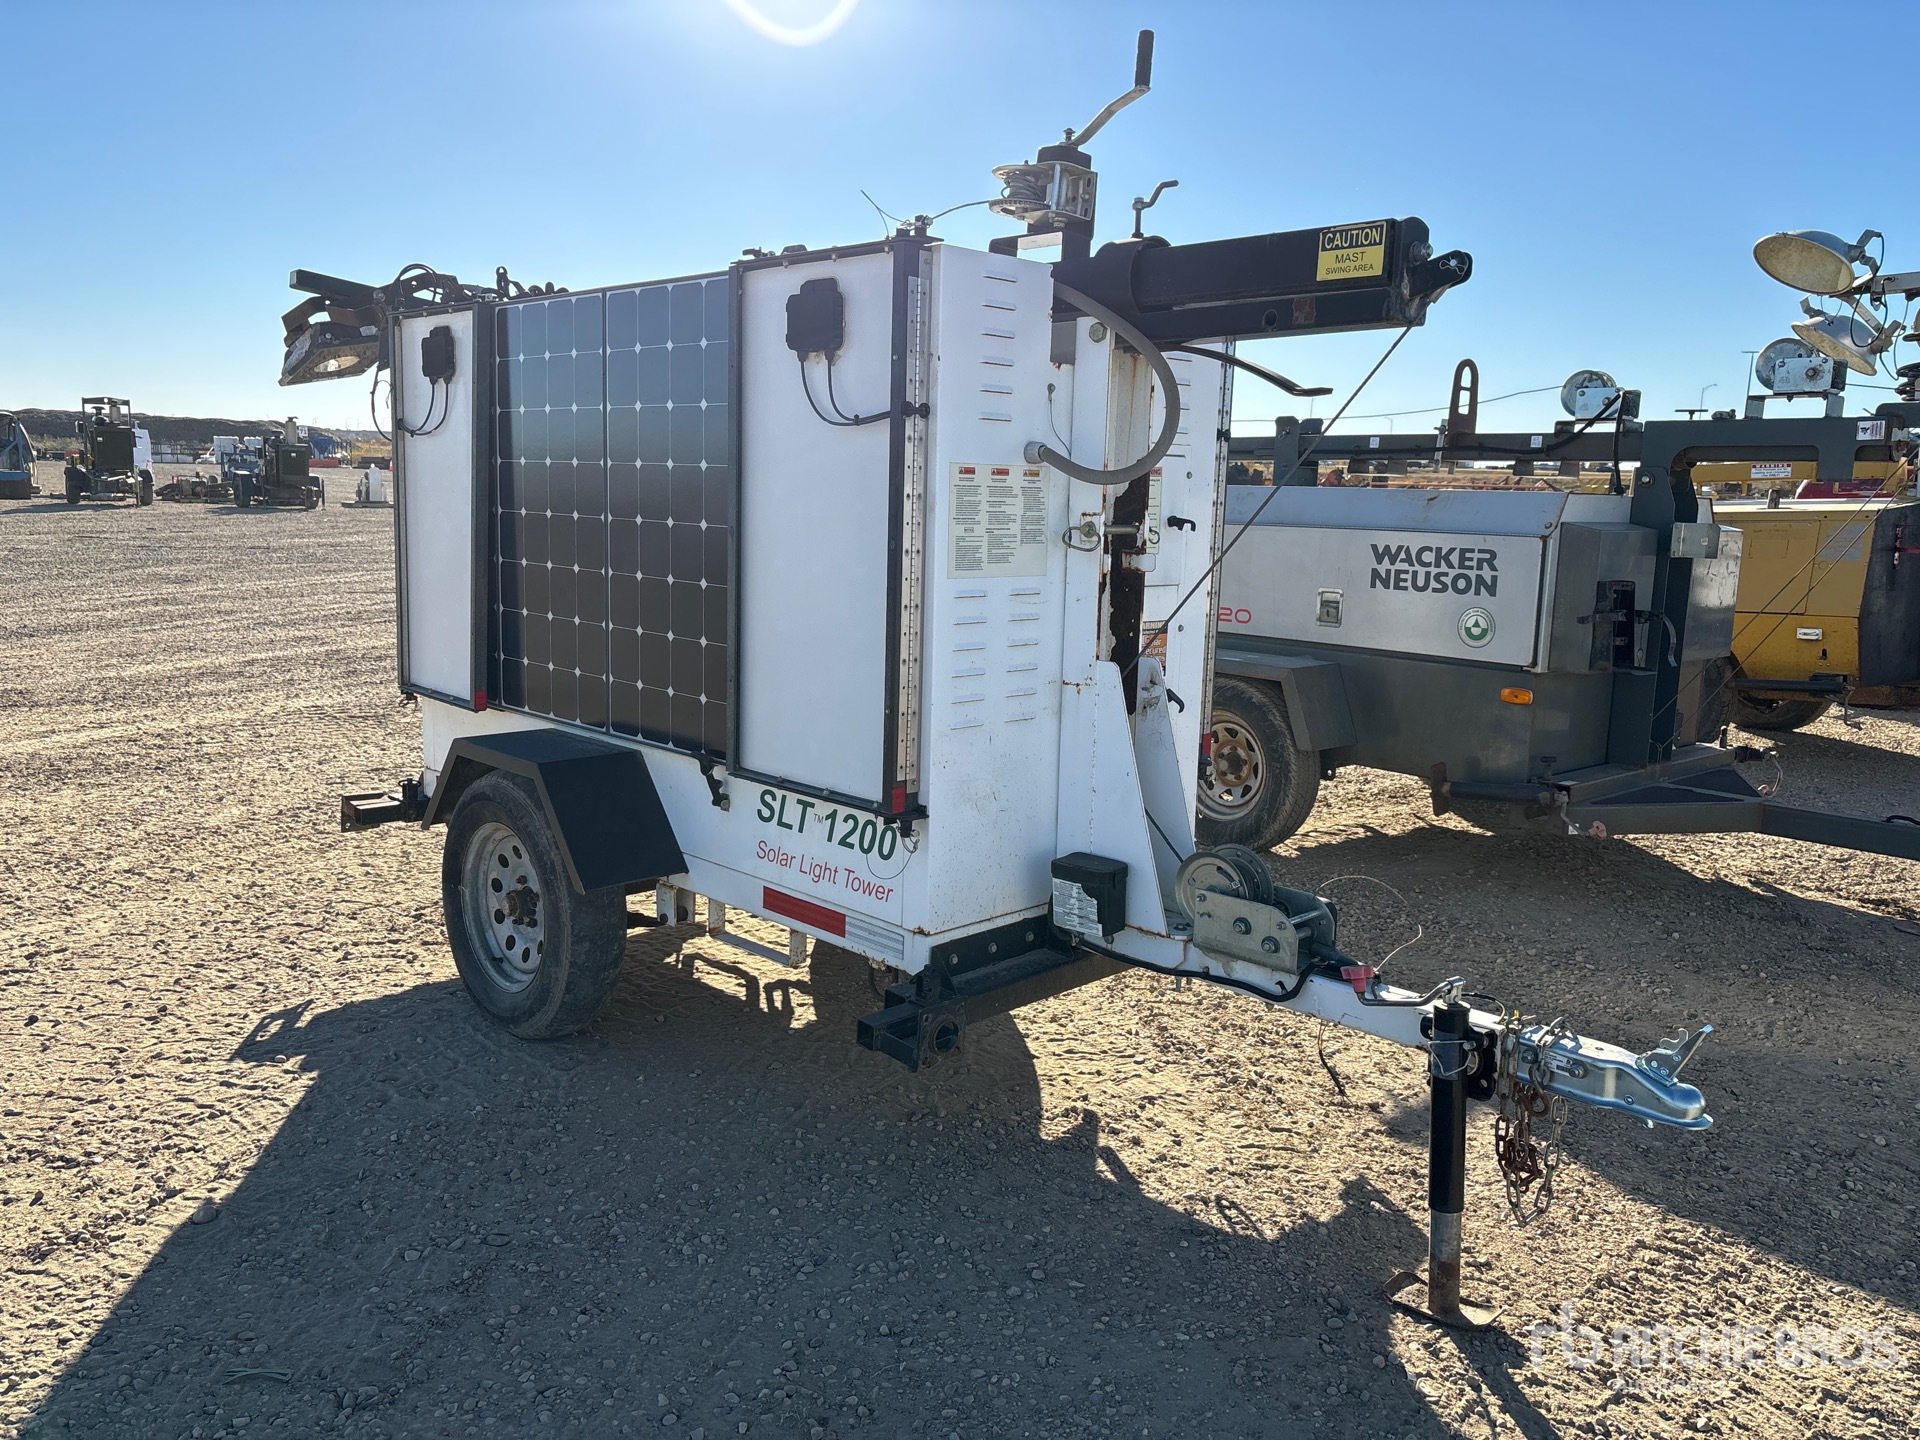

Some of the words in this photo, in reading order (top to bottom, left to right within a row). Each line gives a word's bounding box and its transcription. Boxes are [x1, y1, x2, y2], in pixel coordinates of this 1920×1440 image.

[1324, 228, 1380, 249] CAUTION
[1325, 265, 1351, 275] SWING
[1352, 263, 1374, 273] AREA
[1335, 251, 1366, 264] MAST
[1370, 543, 1499, 572] WACKER
[1370, 567, 1498, 598] NEUSON
[1218, 606, 1252, 625] 20
[757, 789, 816, 834] SLT
[824, 808, 898, 861] 1200
[756, 840, 797, 869] Solar
[799, 853, 839, 884] Light
[844, 867, 894, 903] Tower
